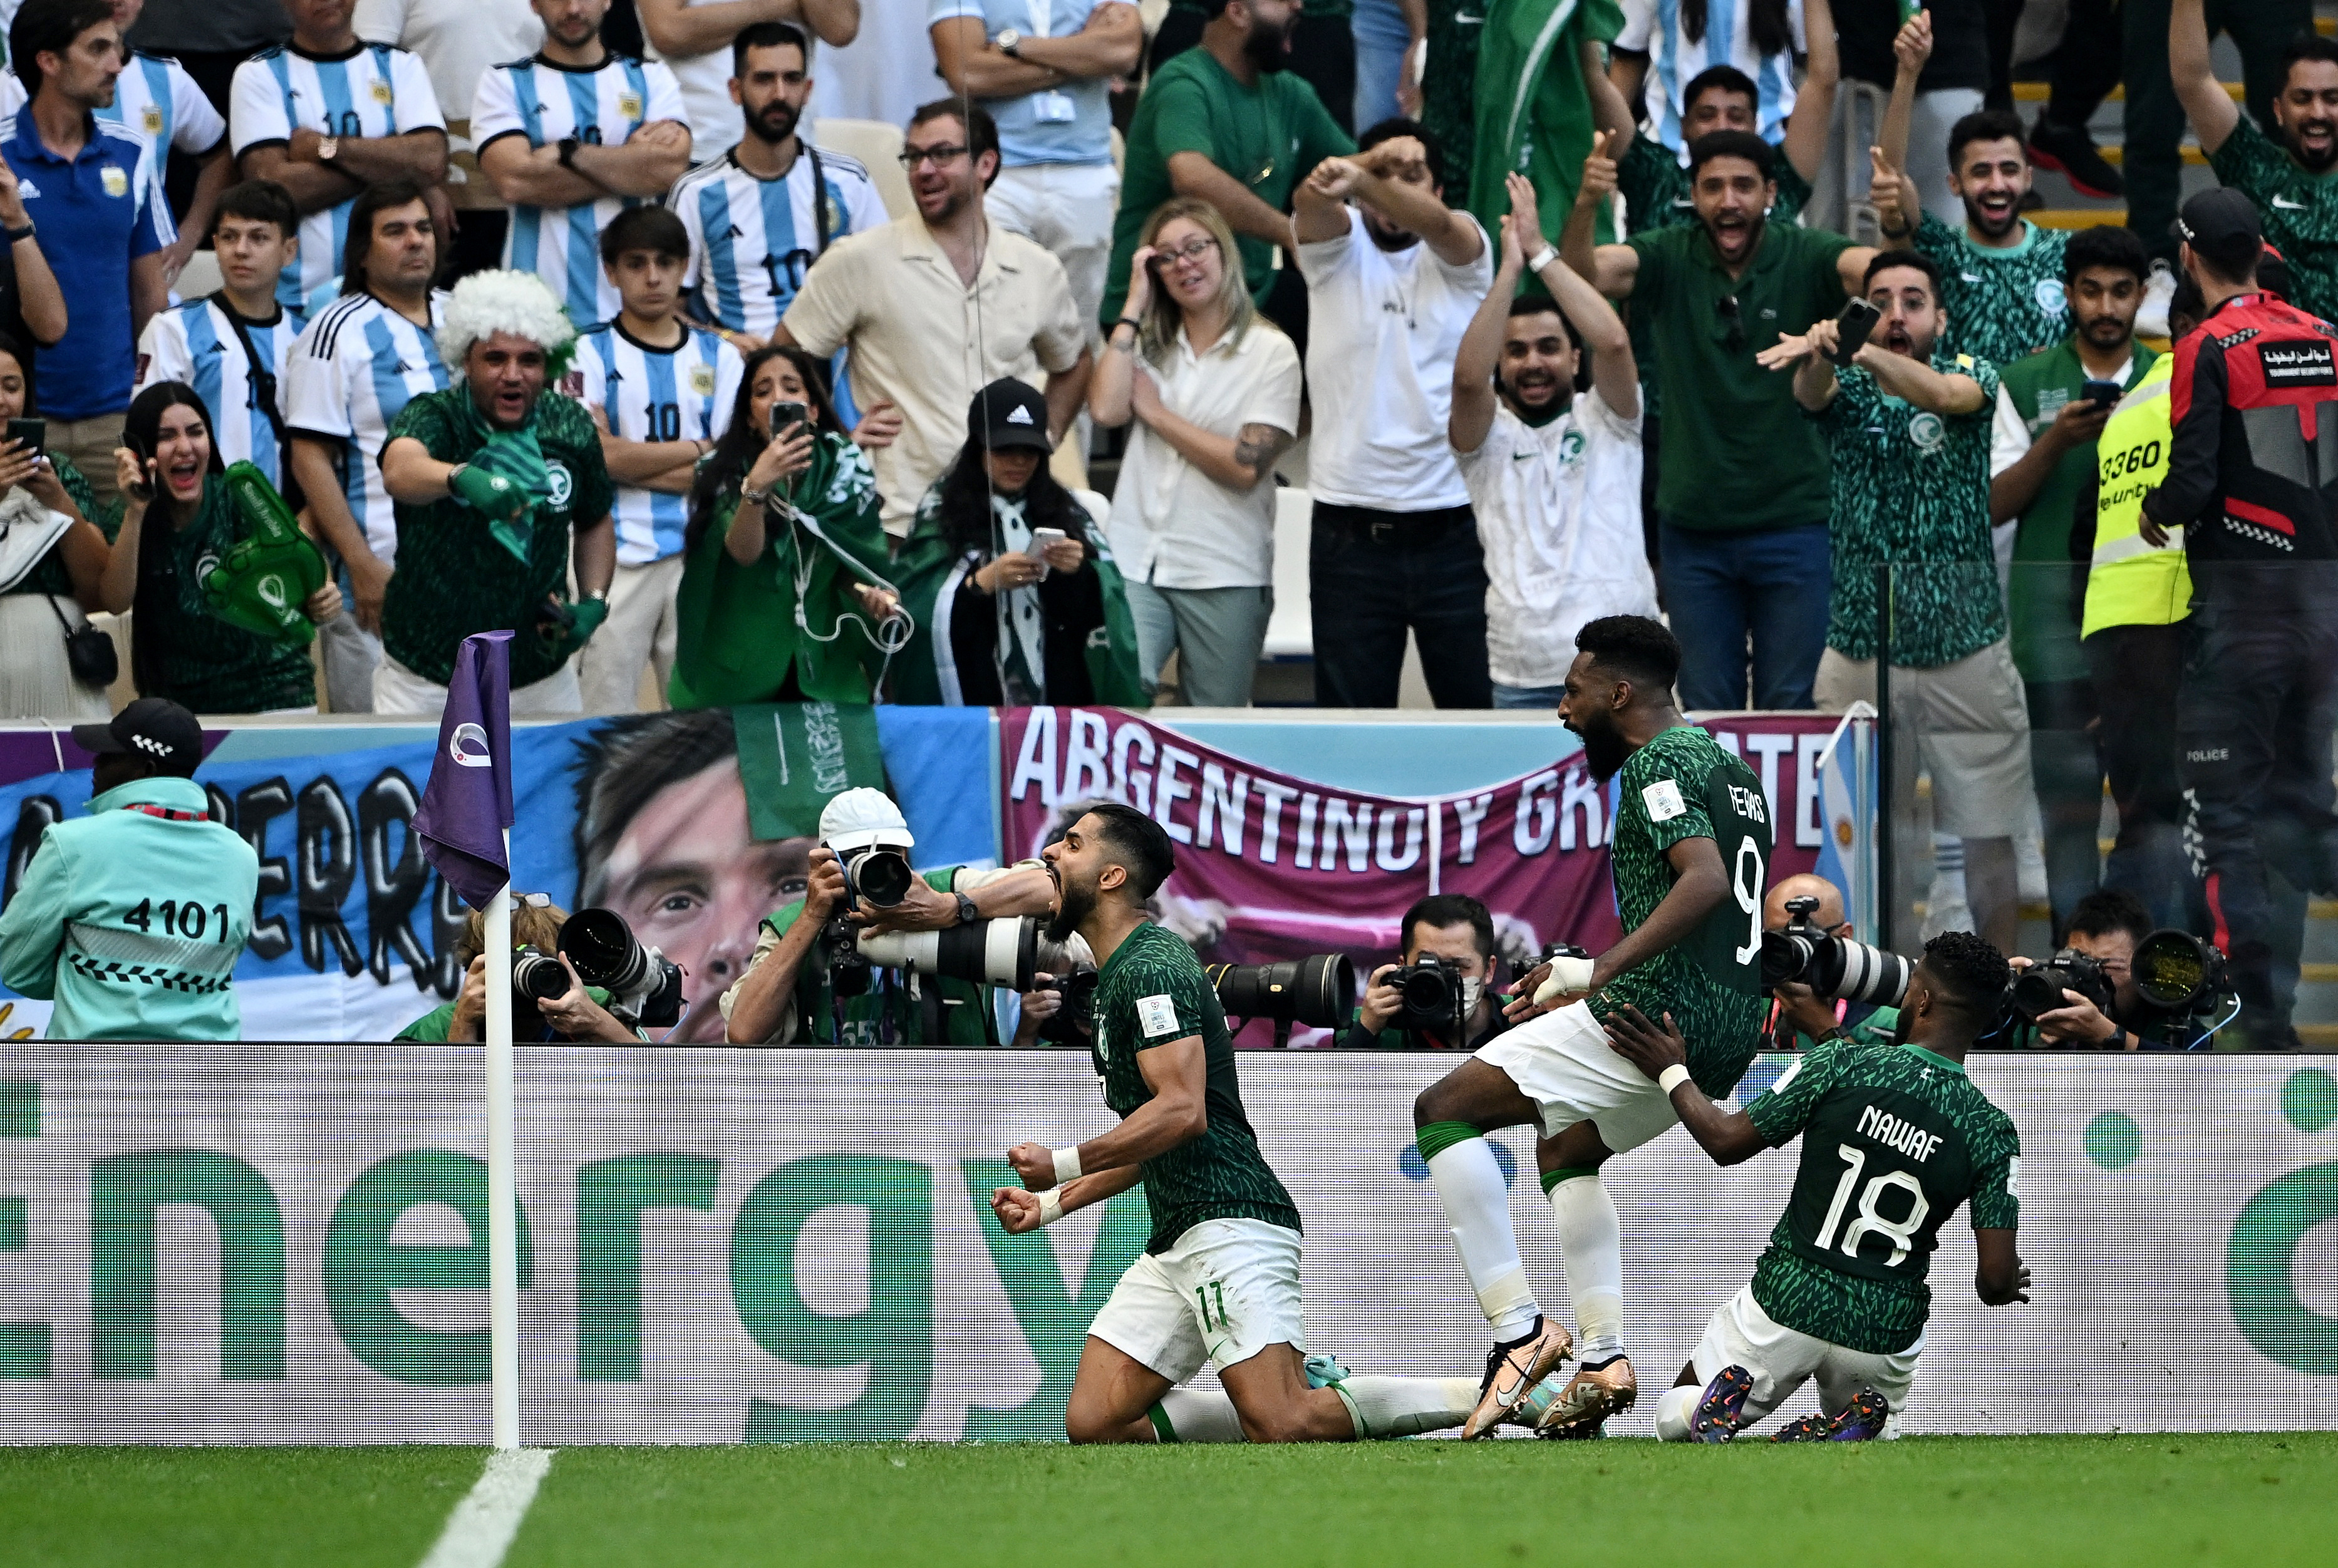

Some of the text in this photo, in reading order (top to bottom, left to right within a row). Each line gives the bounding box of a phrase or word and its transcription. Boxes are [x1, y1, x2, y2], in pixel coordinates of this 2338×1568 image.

[644, 401, 681, 443] 10
[2100, 440, 2160, 487] 3360
[1453, 792, 1494, 864] Y
[1727, 783, 1765, 824] FERAS
[123, 897, 229, 944] 4101
[1733, 835, 1764, 966] 9
[1856, 1105, 1944, 1163] NAWAF
[1814, 1143, 1930, 1267] 18
[1195, 1281, 1229, 1334] 11
